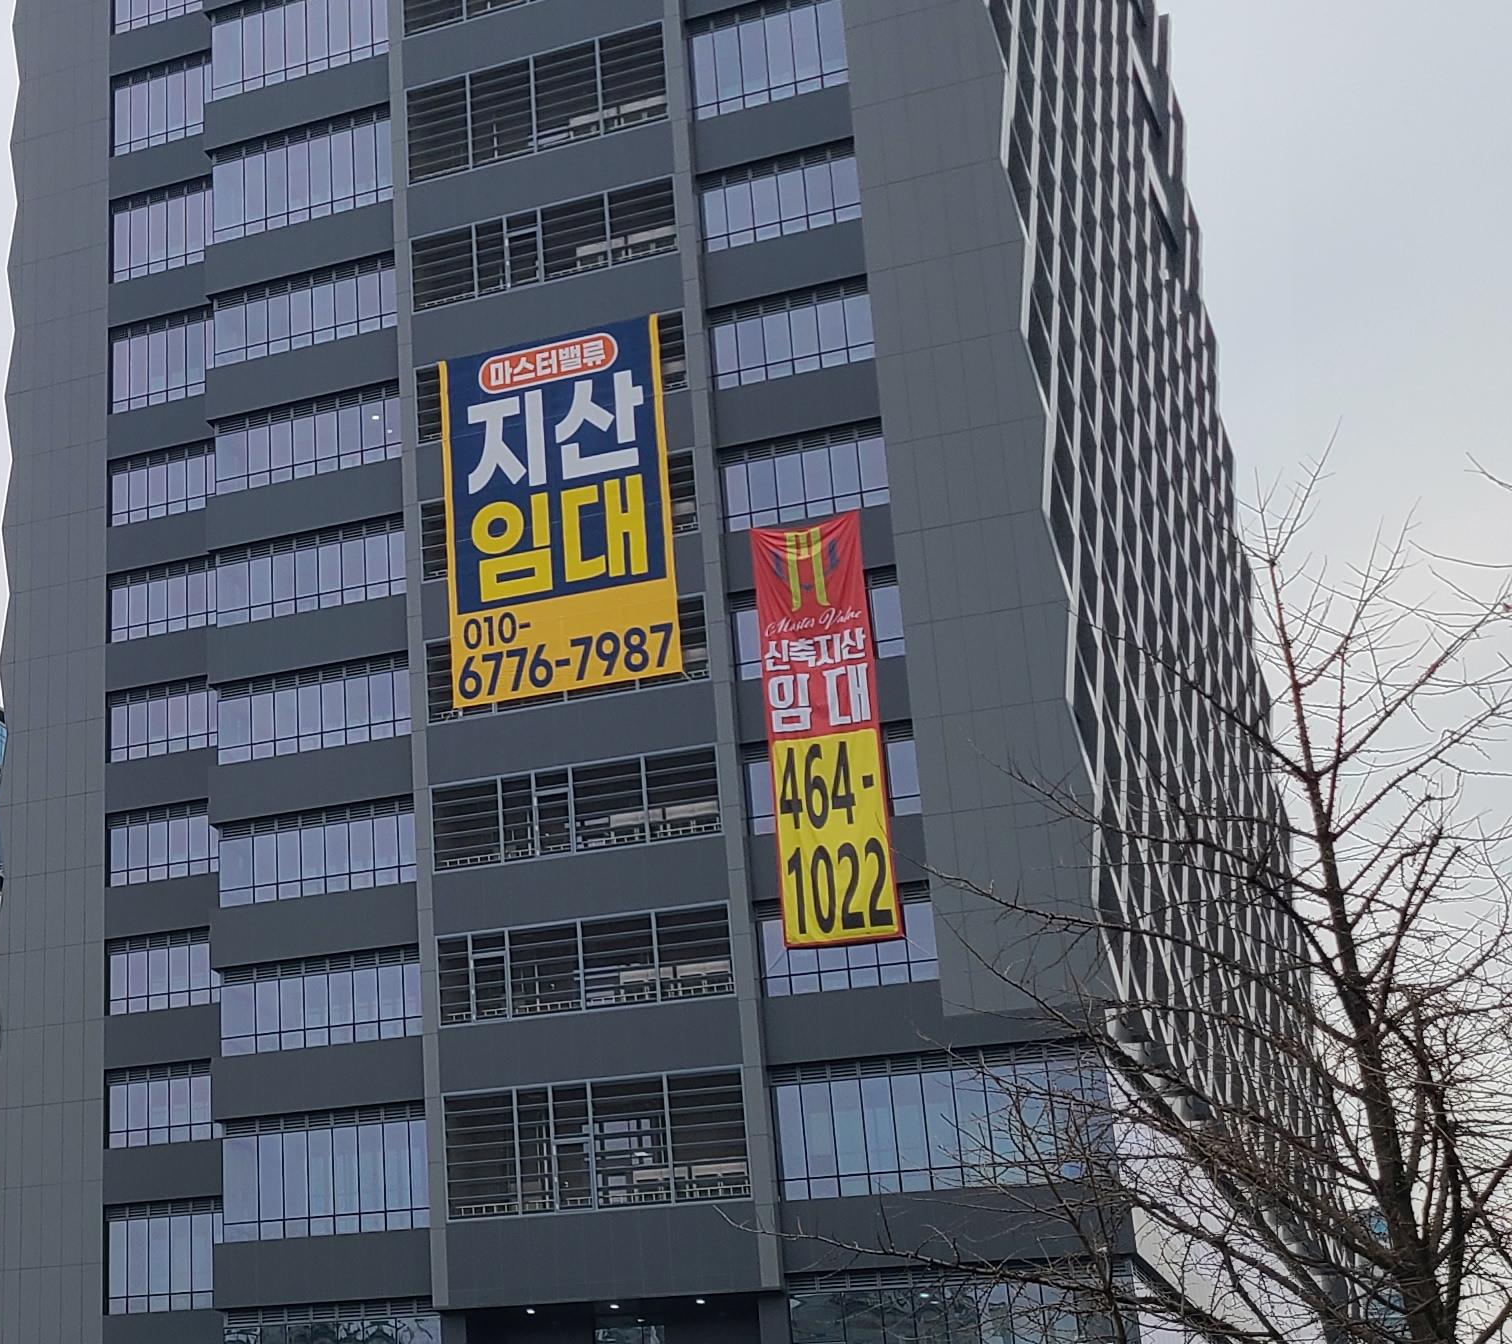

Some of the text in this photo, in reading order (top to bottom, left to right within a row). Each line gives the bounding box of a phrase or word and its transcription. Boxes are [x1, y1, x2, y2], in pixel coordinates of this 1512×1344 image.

[490, 339, 606, 387] 마스터밸류
[467, 370, 644, 495] 지산
[471, 473, 648, 602] 임대
[458, 622, 674, 700] 6776-7987
[463, 612, 531, 650] 010-
[764, 627, 866, 671] 신축지산
[780, 741, 874, 830] 464-
[788, 837, 893, 935] 1022
